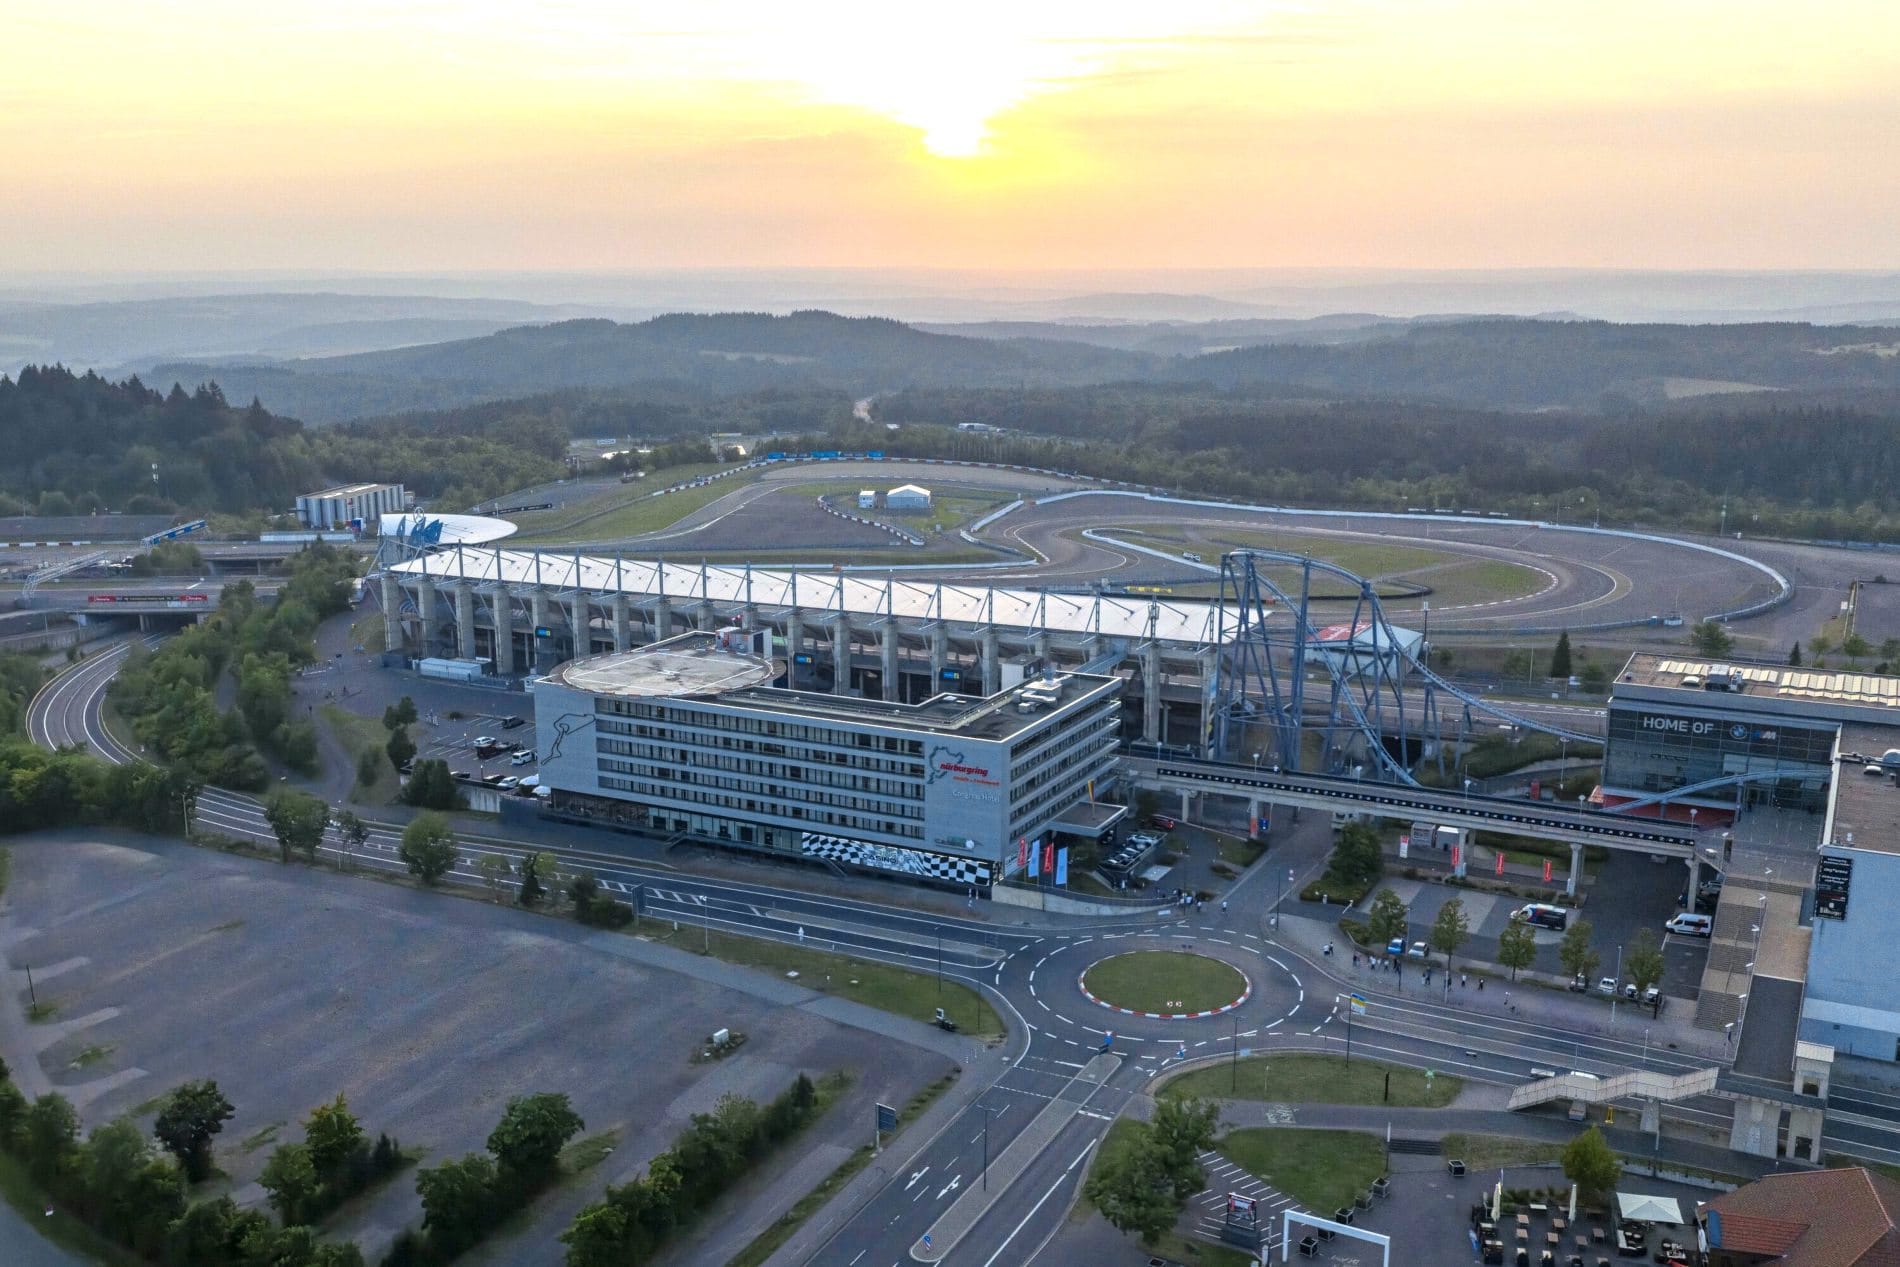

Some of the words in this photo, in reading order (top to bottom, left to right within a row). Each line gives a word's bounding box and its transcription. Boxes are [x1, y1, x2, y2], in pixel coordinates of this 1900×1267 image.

[1643, 716, 1689, 732] HOME
[1692, 722, 1714, 734] OF
[862, 854, 897, 864] CASINO
